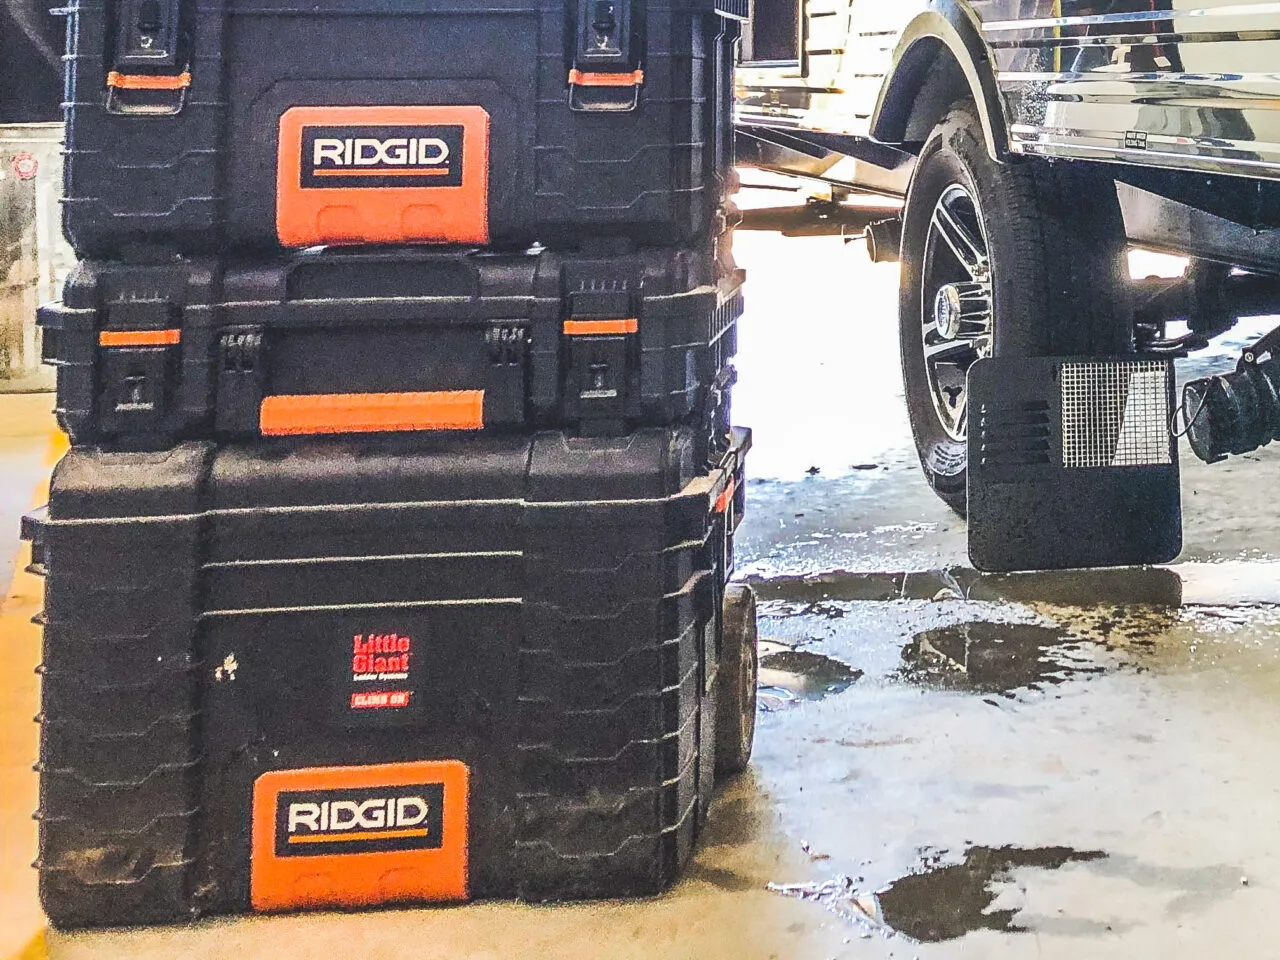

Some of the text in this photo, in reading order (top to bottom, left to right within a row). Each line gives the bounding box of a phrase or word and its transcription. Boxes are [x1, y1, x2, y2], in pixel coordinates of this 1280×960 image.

[313, 138, 449, 165] RIDGID
[353, 633, 410, 653] Little
[352, 652, 409, 672] Giant
[288, 797, 429, 832] RIDGID
